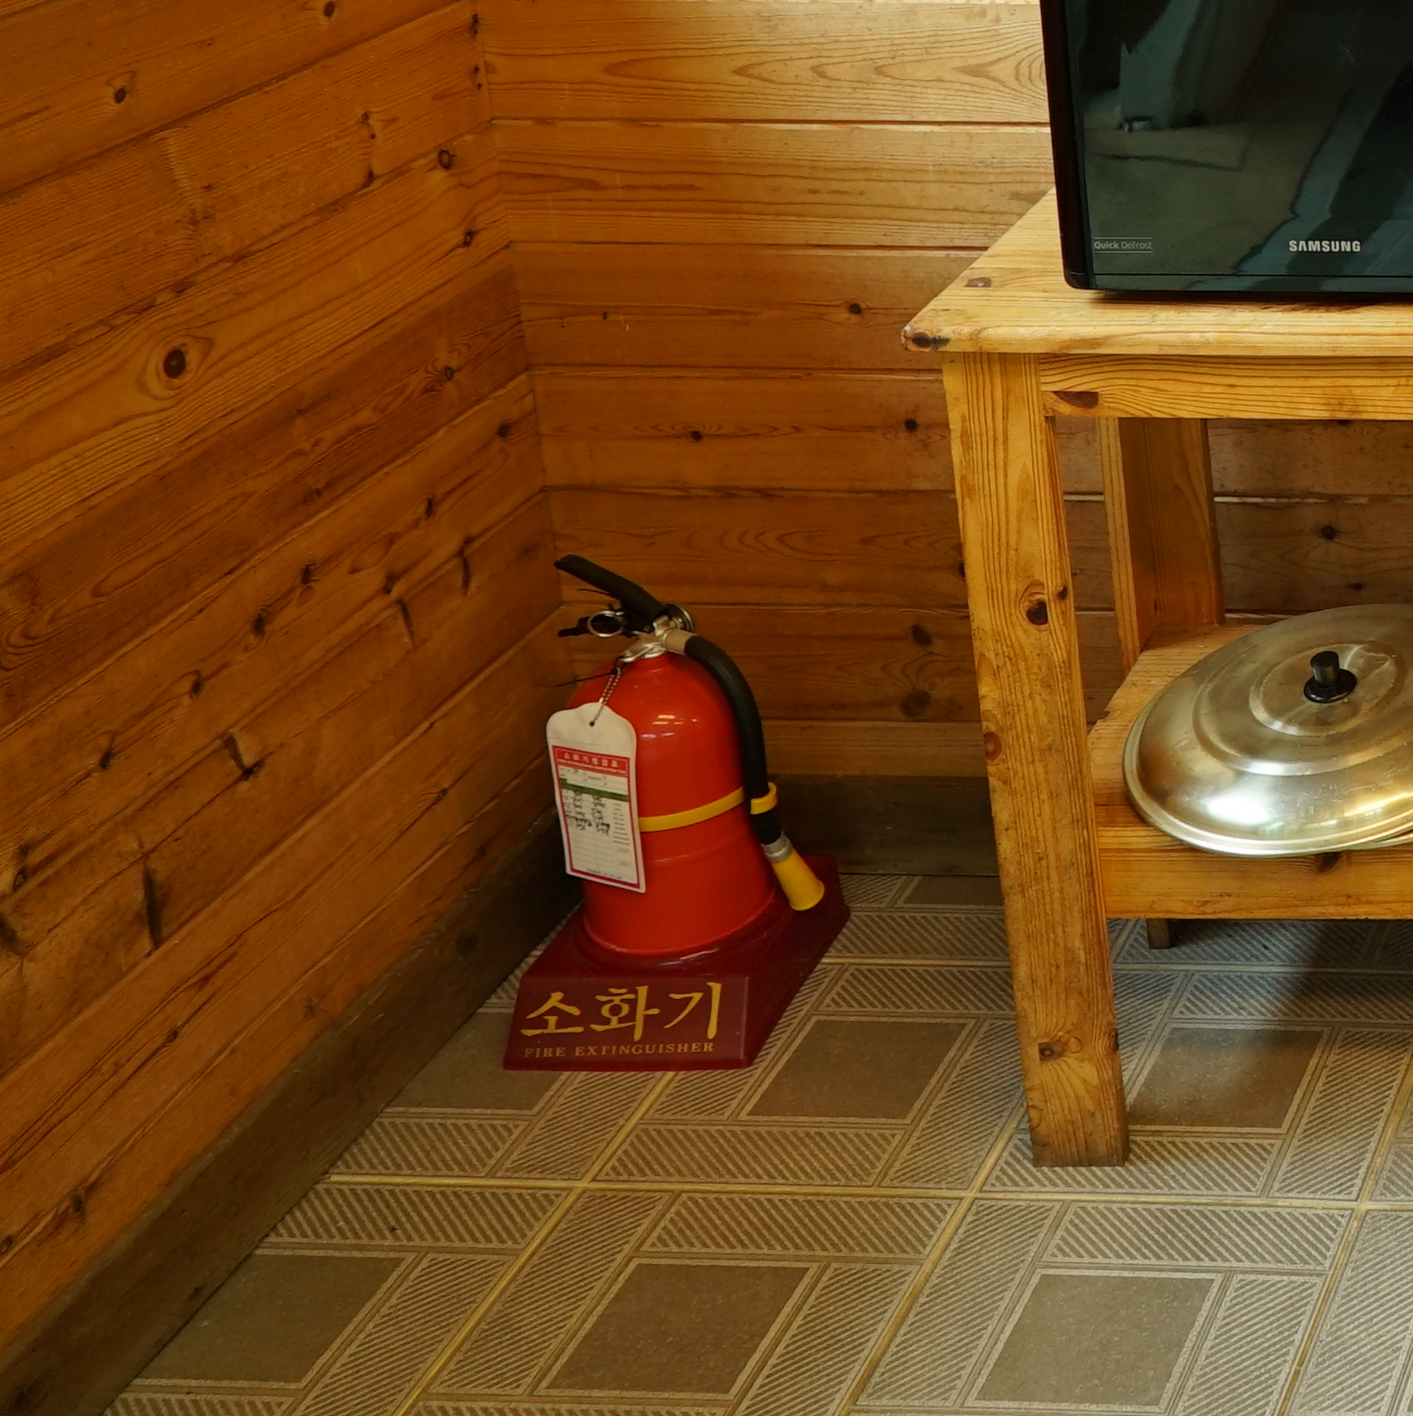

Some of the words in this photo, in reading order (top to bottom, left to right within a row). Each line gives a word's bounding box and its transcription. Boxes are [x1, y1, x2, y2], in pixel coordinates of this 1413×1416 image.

[1094, 241, 1119, 250] Quick
[1121, 240, 1152, 250] Defrost
[1288, 240, 1361, 253] SAMSUNG
[520, 981, 722, 1042] 소화기
[523, 1047, 566, 1058] FIRE
[575, 1042, 714, 1057] EXTINGUISHER
